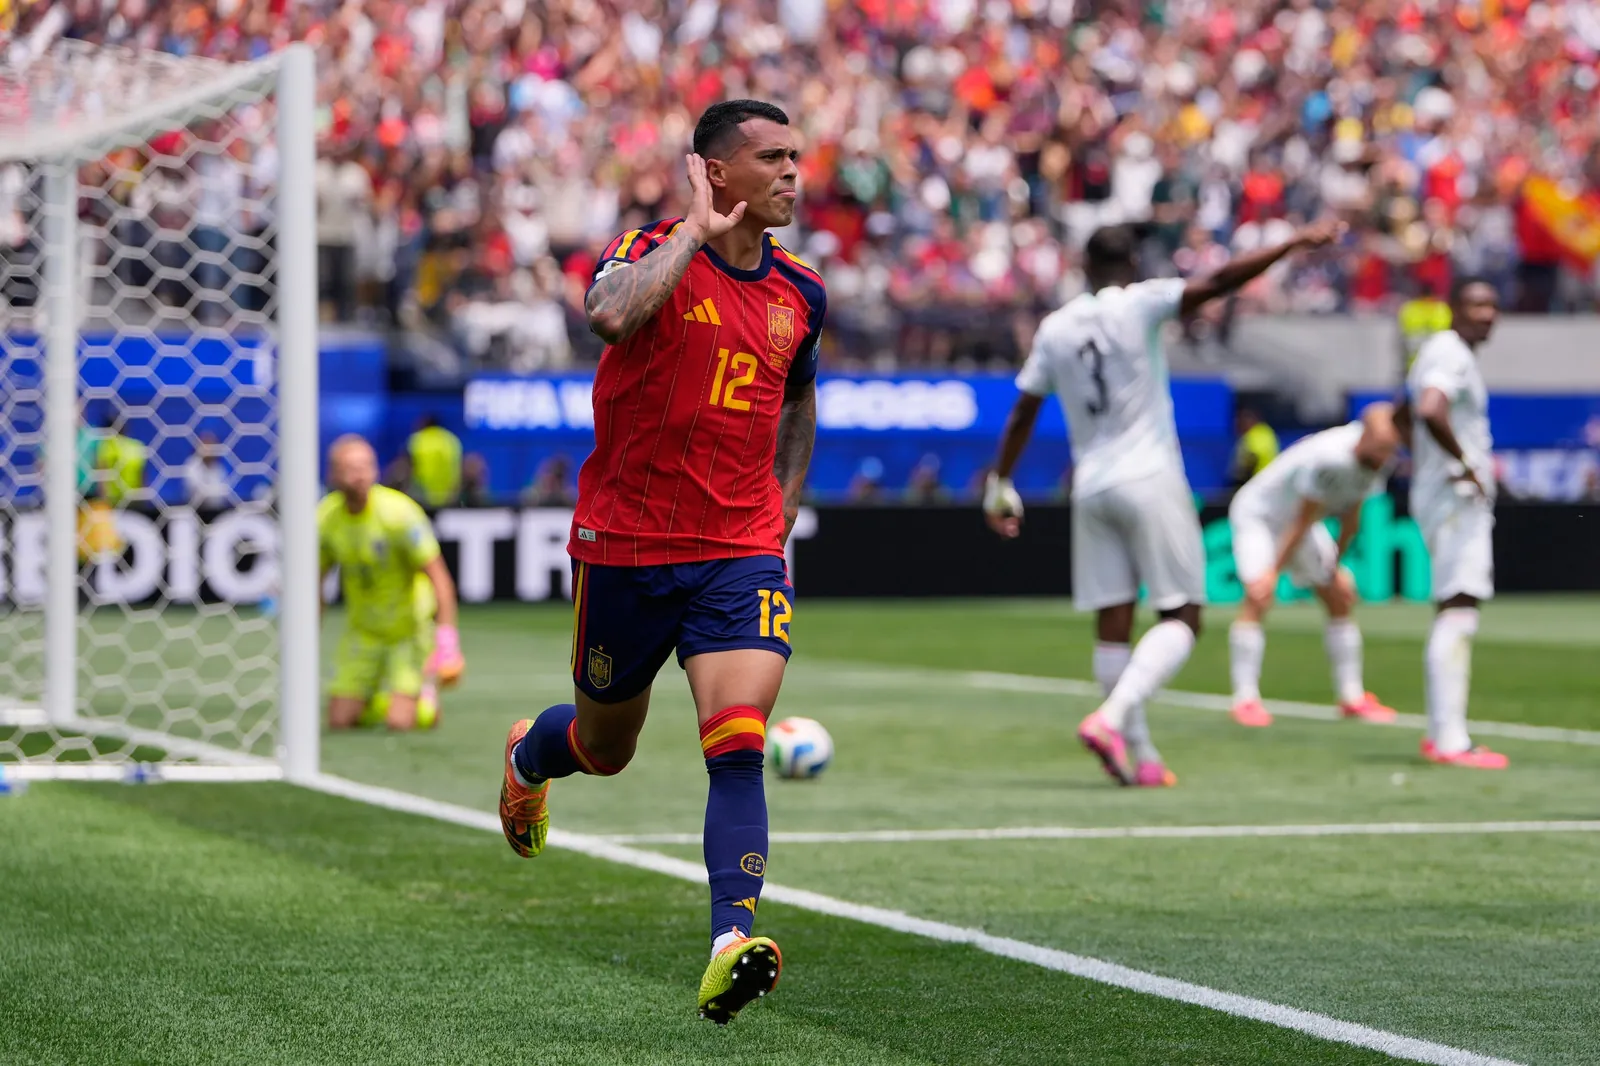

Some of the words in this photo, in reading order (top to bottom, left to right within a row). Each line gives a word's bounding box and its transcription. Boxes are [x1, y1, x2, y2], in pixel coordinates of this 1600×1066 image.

[708, 347, 758, 411] 12
[1078, 337, 1109, 416] 3
[0, 507, 340, 602] EDIC
[757, 589, 793, 644] 12
